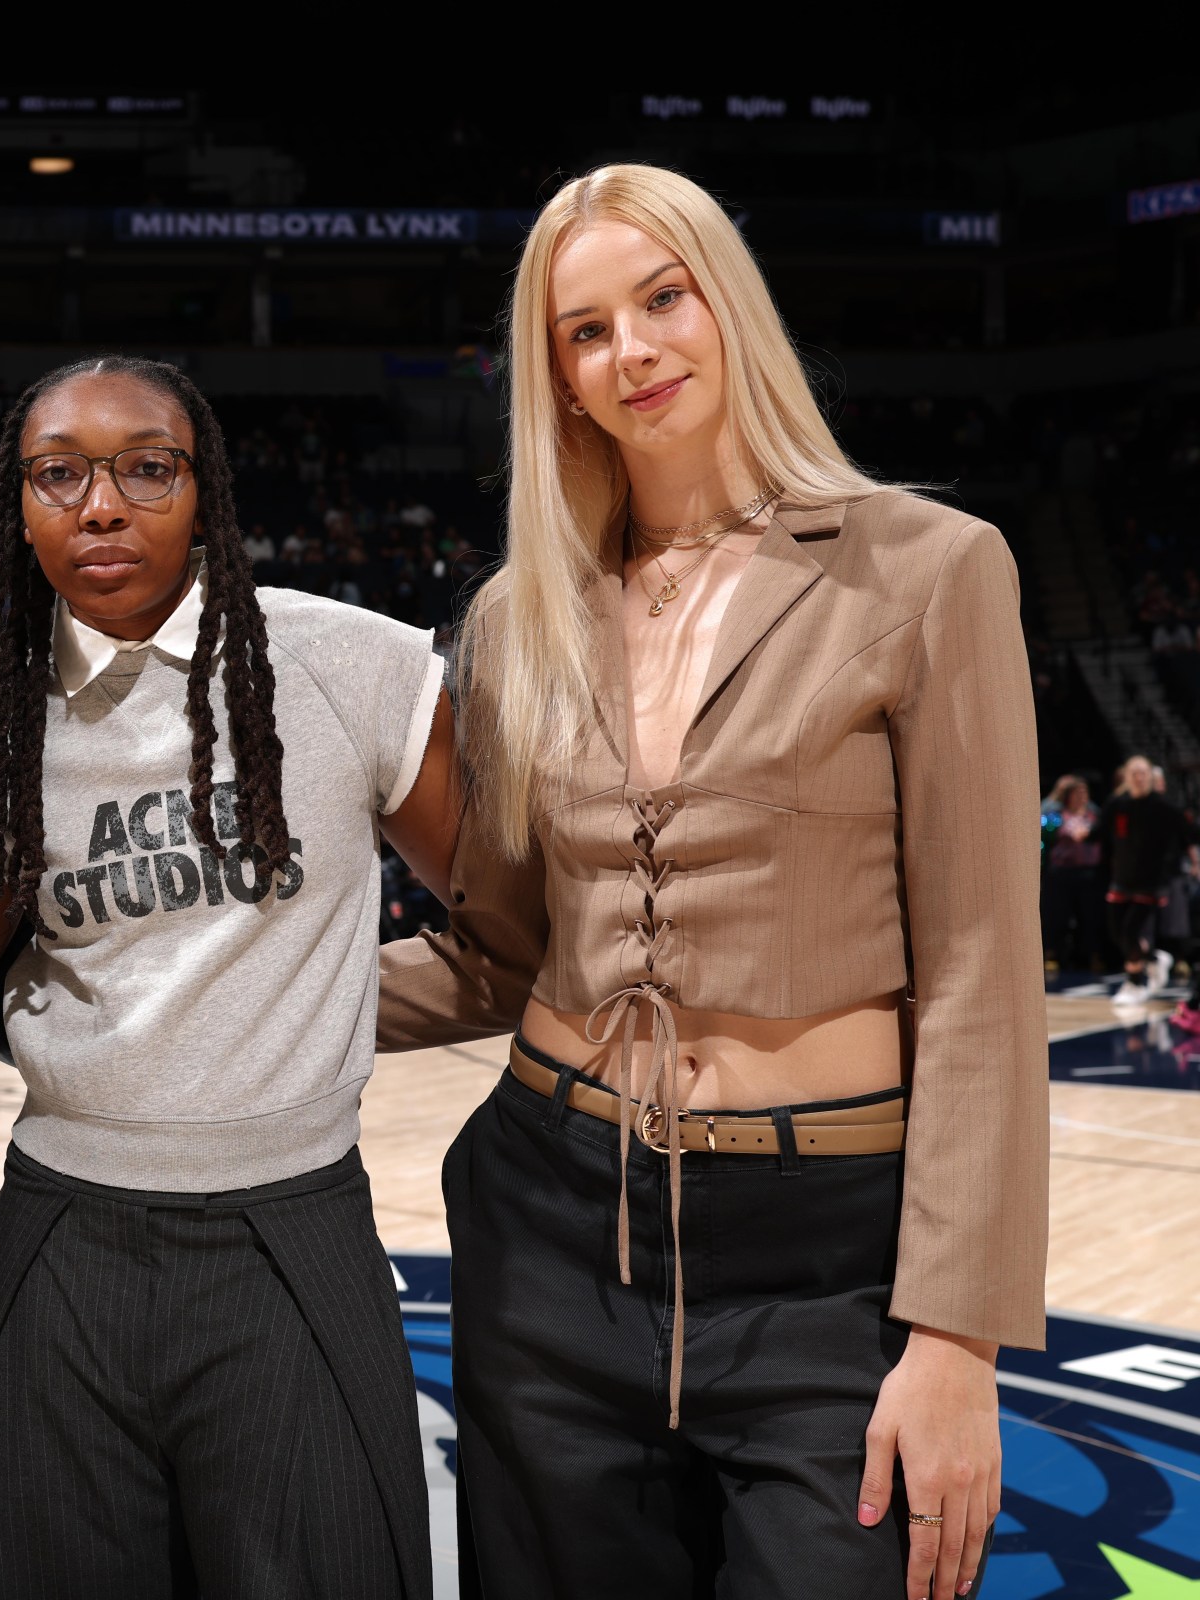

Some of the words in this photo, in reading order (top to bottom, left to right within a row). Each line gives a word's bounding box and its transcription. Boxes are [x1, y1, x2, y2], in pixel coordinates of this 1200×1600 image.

[130, 212, 358, 238] MINNESOTA
[365, 213, 463, 238] LYNX
[53, 837, 305, 929] STUDIOS
